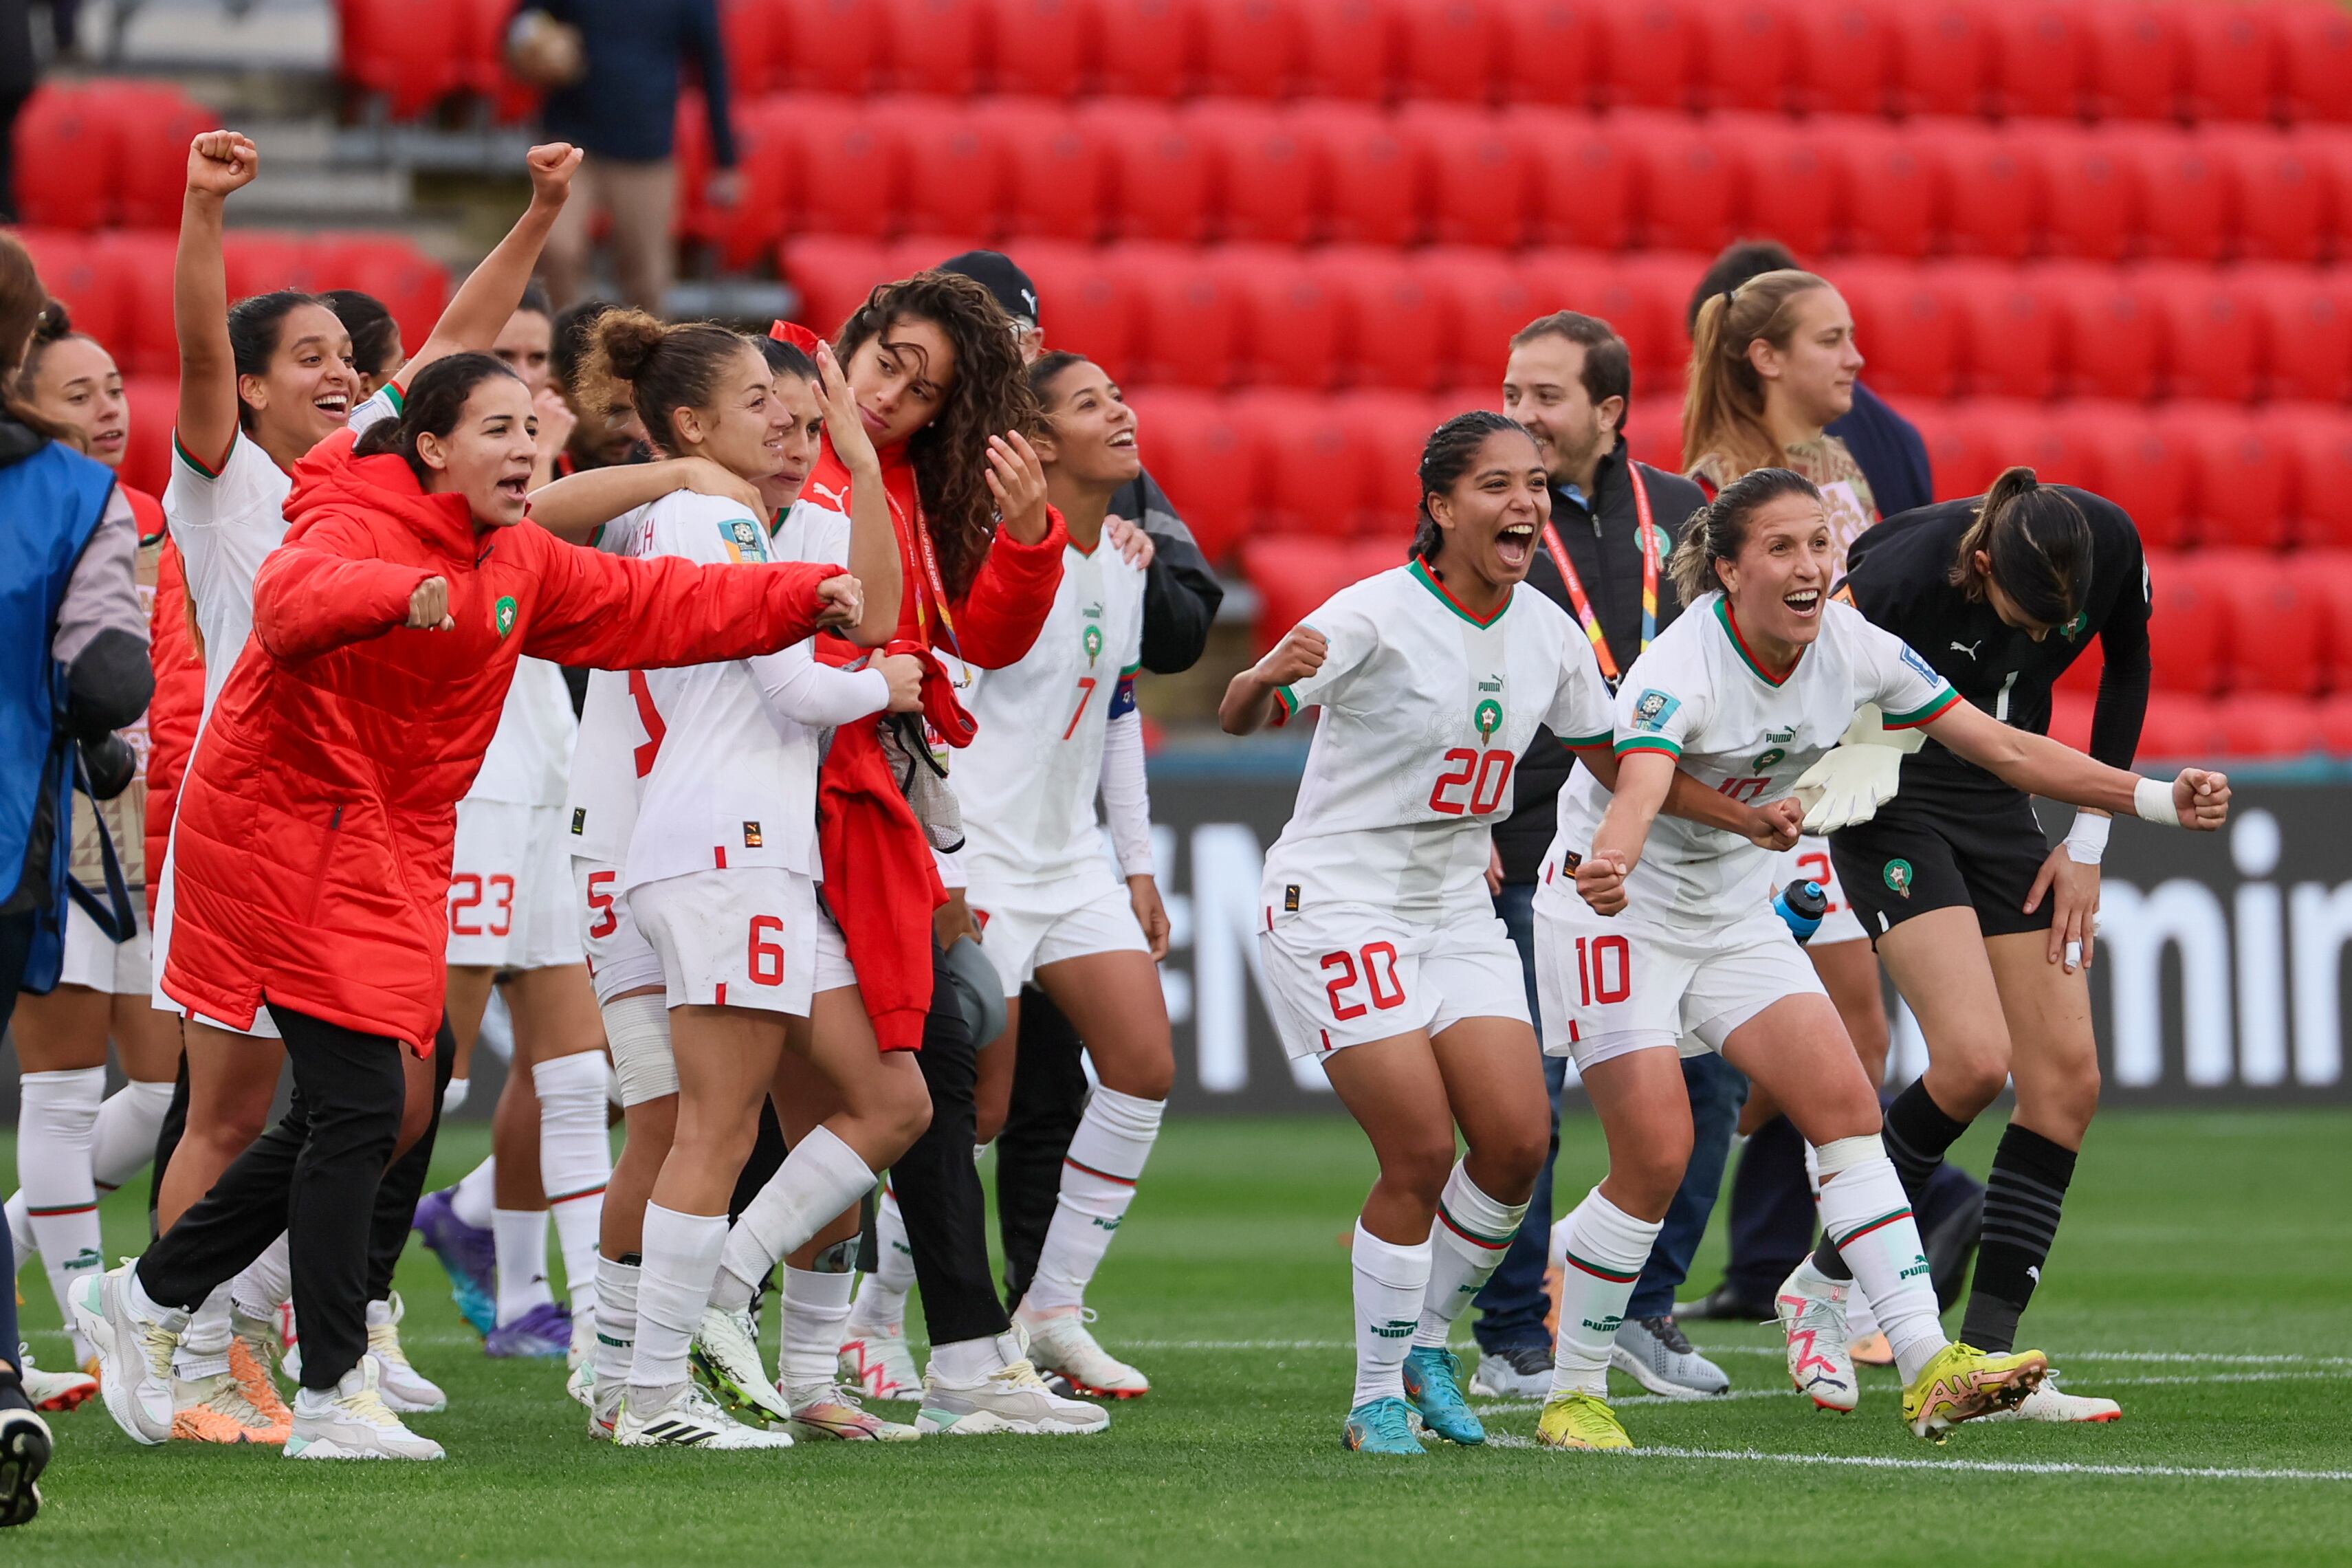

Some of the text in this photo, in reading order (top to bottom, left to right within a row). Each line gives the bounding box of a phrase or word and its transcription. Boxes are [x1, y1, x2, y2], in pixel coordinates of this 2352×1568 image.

[1063, 676, 1097, 740] 7
[1478, 681, 1500, 692] PUMA
[1996, 670, 2019, 720] 1
[1766, 733, 1792, 743] PUMA
[1429, 748, 1515, 815] 20
[450, 873, 514, 936] 23
[589, 871, 617, 939] 5
[748, 915, 784, 986] 6
[1319, 941, 1406, 1022] 20
[1575, 935, 1630, 1006] 10
[1370, 1324, 1415, 1338] PUMA
